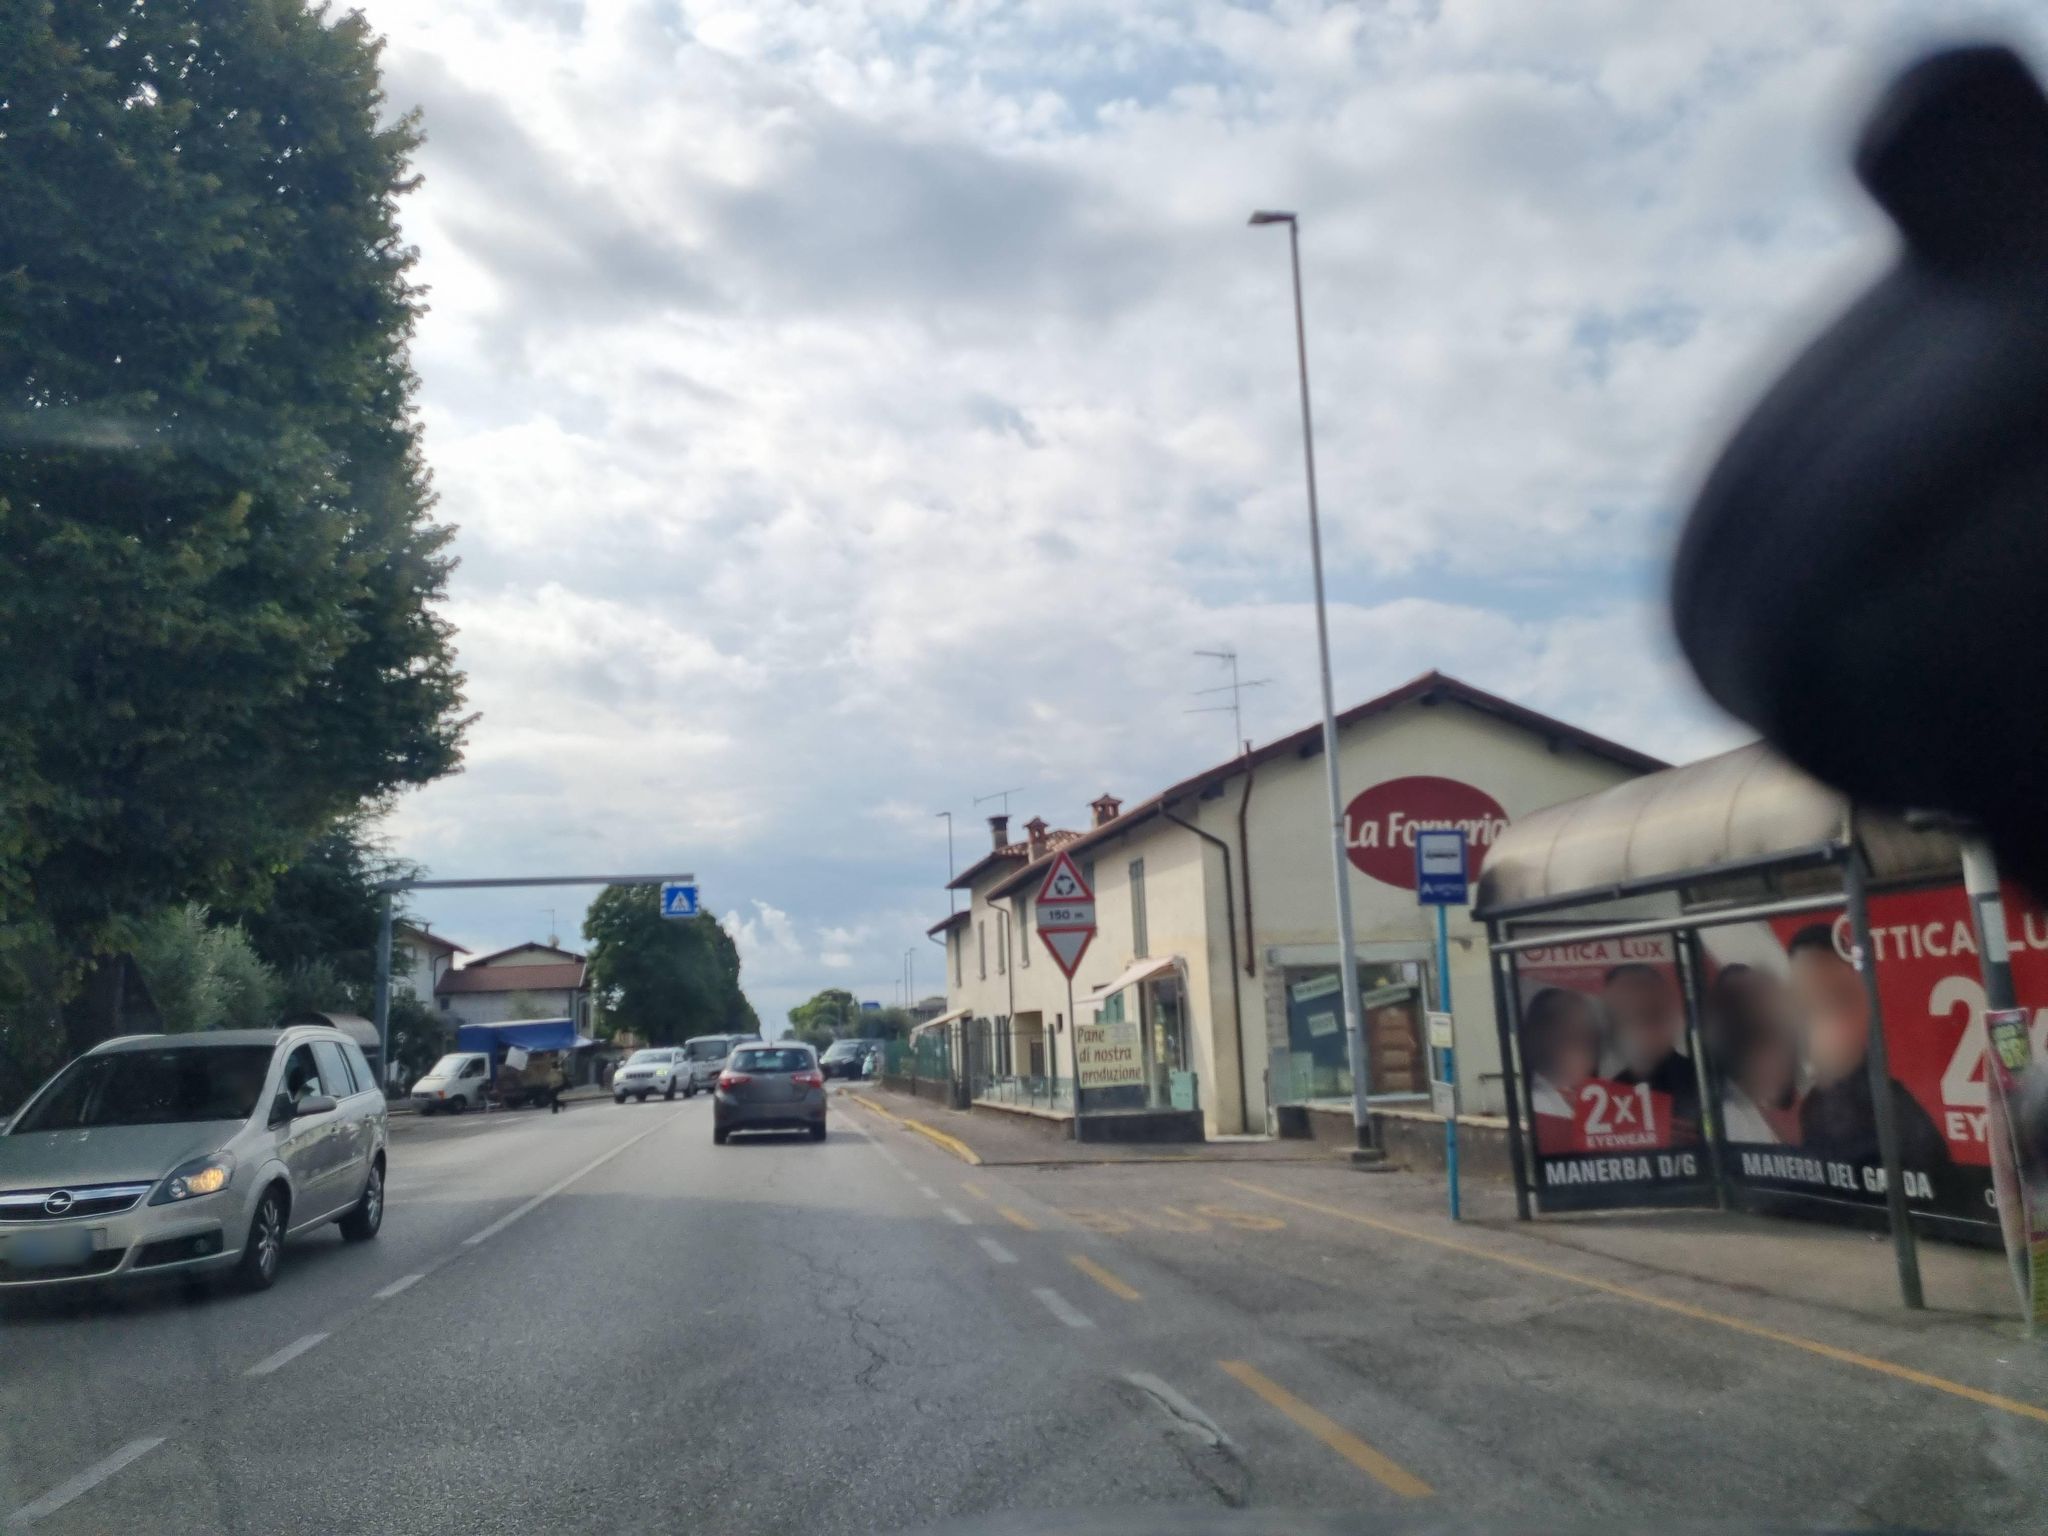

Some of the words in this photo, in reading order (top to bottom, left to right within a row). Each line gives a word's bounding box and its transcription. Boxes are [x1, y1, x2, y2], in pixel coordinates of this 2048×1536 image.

[1344, 814, 1379, 848] La
[1049, 910, 1070, 920] 150
[1074, 912, 1084, 920] m
[1077, 1027, 1104, 1044] Pane
[1079, 1047, 1090, 1063] di
[1094, 1047, 1131, 1063] nostra
[1081, 1066, 1142, 1083] produzione
[1545, 1157, 1652, 1185] MANERBA
[1660, 1153, 1697, 1178] D/G
[1742, 1152, 1825, 1185] MANERBA
[1826, 1162, 1859, 1190] DEL
[1862, 1166, 1934, 1199] GADA
